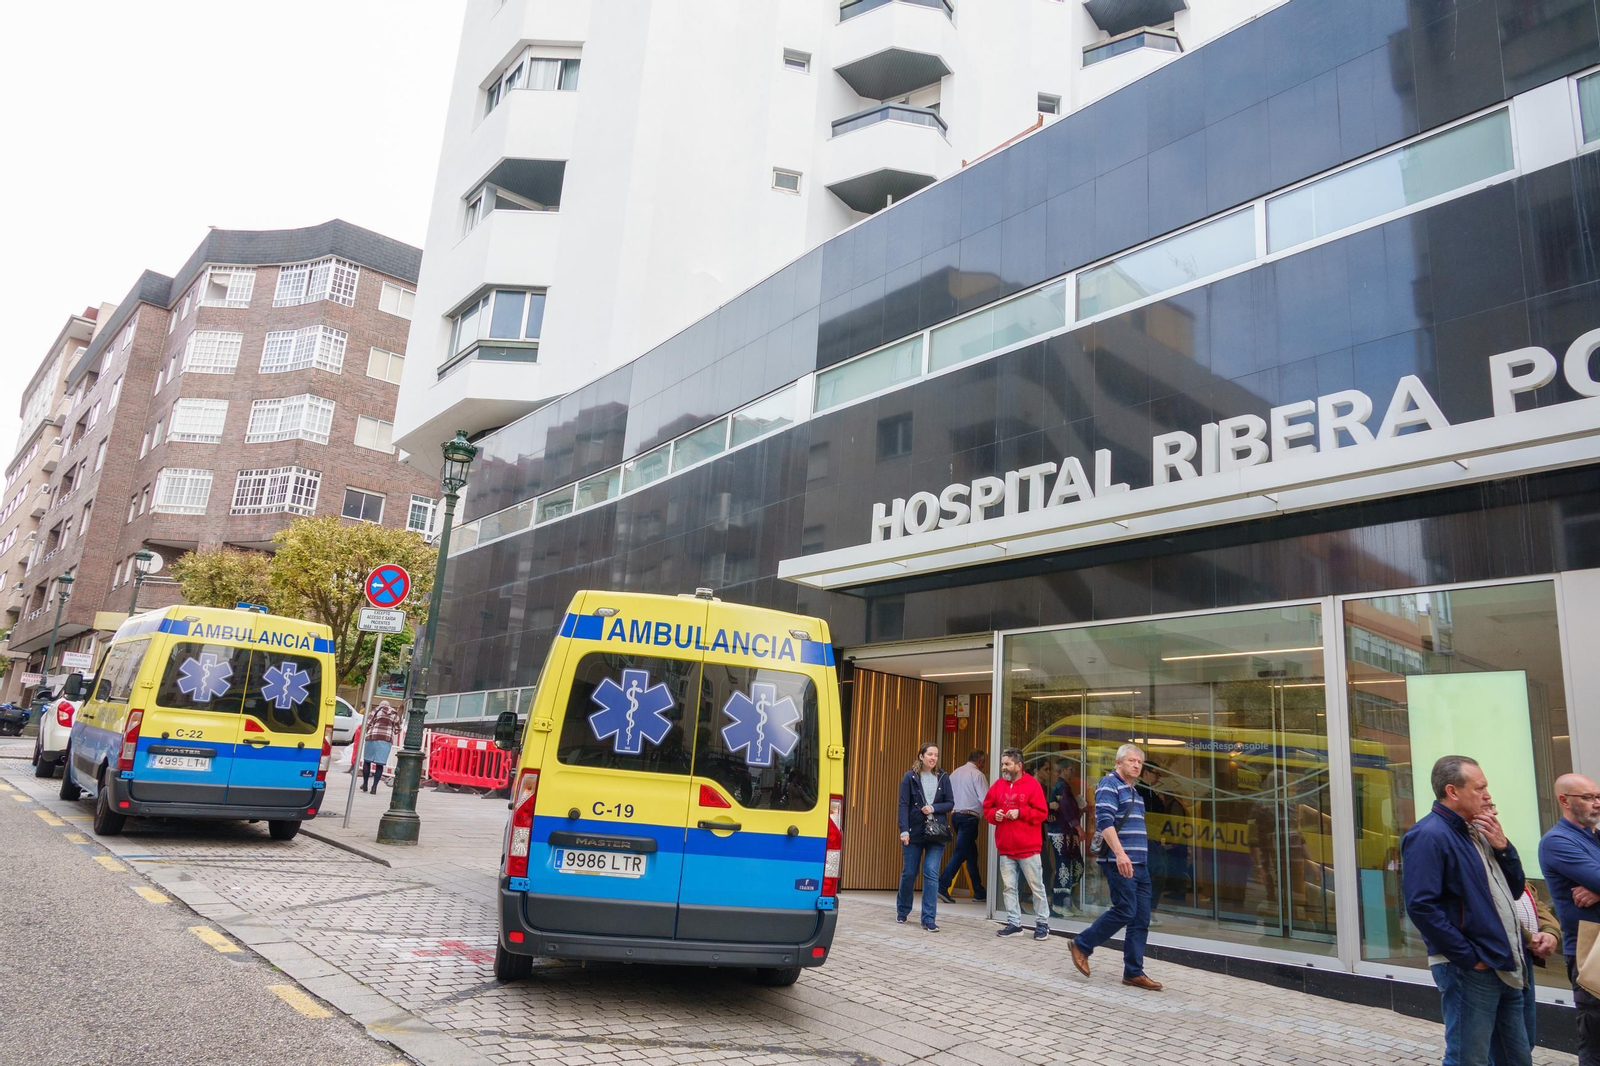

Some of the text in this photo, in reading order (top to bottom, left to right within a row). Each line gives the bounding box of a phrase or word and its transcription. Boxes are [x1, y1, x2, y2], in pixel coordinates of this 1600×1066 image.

[871, 448, 1131, 543] HOSPITAL
[1152, 374, 1452, 487] RIBERA
[191, 622, 311, 651] AMBULANCIA
[606, 617, 796, 662] AMBULANCIA
[175, 728, 204, 739] C-22
[165, 747, 202, 755] MASTER
[1185, 740, 1269, 752] #SaludResponsable
[157, 756, 207, 769] 4995 LTM
[592, 801, 634, 818] C-19
[575, 837, 632, 849] MASTER
[566, 852, 642, 872] 9986 LTR
